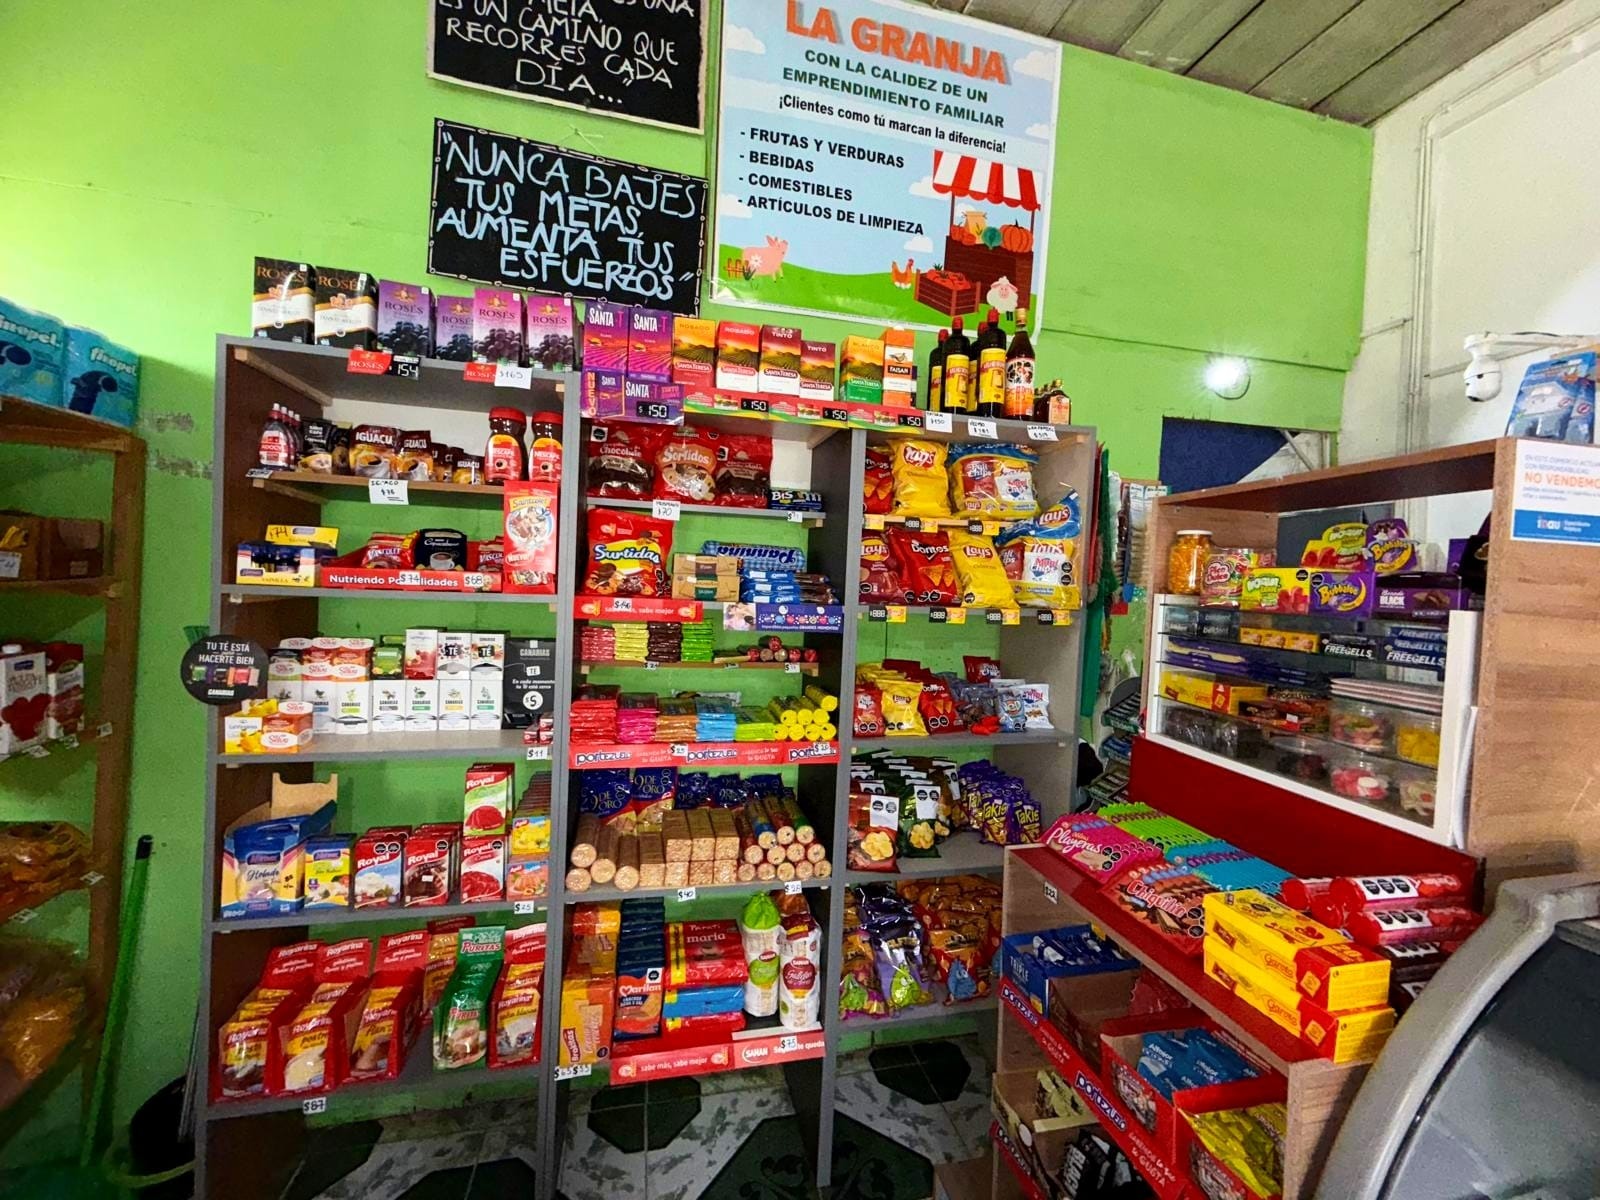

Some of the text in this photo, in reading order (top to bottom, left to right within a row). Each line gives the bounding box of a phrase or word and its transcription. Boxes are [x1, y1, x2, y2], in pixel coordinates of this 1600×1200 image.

[518, 7, 622, 50] CAMINO
[633, 31, 678, 65] QUE
[786, 0, 1008, 85] LA GRANJA
[446, 18, 673, 89] RECORRES CADA
[805, 49, 989, 103] CON LA CALIDEZ DE UN
[783, 67, 1005, 128] EMPRENDIMIENTO FAMILIAR
[779, 93, 1007, 154] ¡Clientes como tú marcan la diferencia!
[749, 127, 905, 169] FRUTAS Y VERDURAS
[748, 150, 815, 173] BEBIDAS
[454, 177, 515, 216] TUS
[585, 165, 697, 219] BAJES
[748, 173, 853, 201] COMESTIBLES
[746, 194, 925, 236] ARTÍCULOS DE LIMPIEZA
[436, 207, 675, 276] AUMENTA TUS
[589, 307, 614, 328] SANTA
[633, 313, 658, 332] SANTA
[807, 345, 827, 353] TINTO
[625, 381, 650, 398] SANTA
[662, 446, 711, 466] Sortidos
[1524, 471, 1542, 484] NO
[593, 544, 661, 565] Surtidas
[329, 574, 385, 586] Nutriendo
[1379, 595, 1405, 606] BLACK
[206, 641, 218, 651] TU
[219, 640, 229, 652] TÉ
[1323, 644, 1374, 659] FREEGELLS
[198, 654, 234, 665] HACERTE
[236, 655, 255, 666] BIEN
[1386, 651, 1446, 667] FREEGELLS
[466, 776, 495, 790] Royal
[982, 801, 1009, 822] Takis
[1015, 808, 1040, 825] Takis
[463, 842, 493, 857] Royal
[1046, 827, 1102, 854] Playeras
[357, 852, 390, 870] Royal
[407, 850, 439, 867] Royal
[686, 931, 727, 944] maría
[326, 940, 365, 957] Royarina
[460, 941, 502, 954] PURITAS
